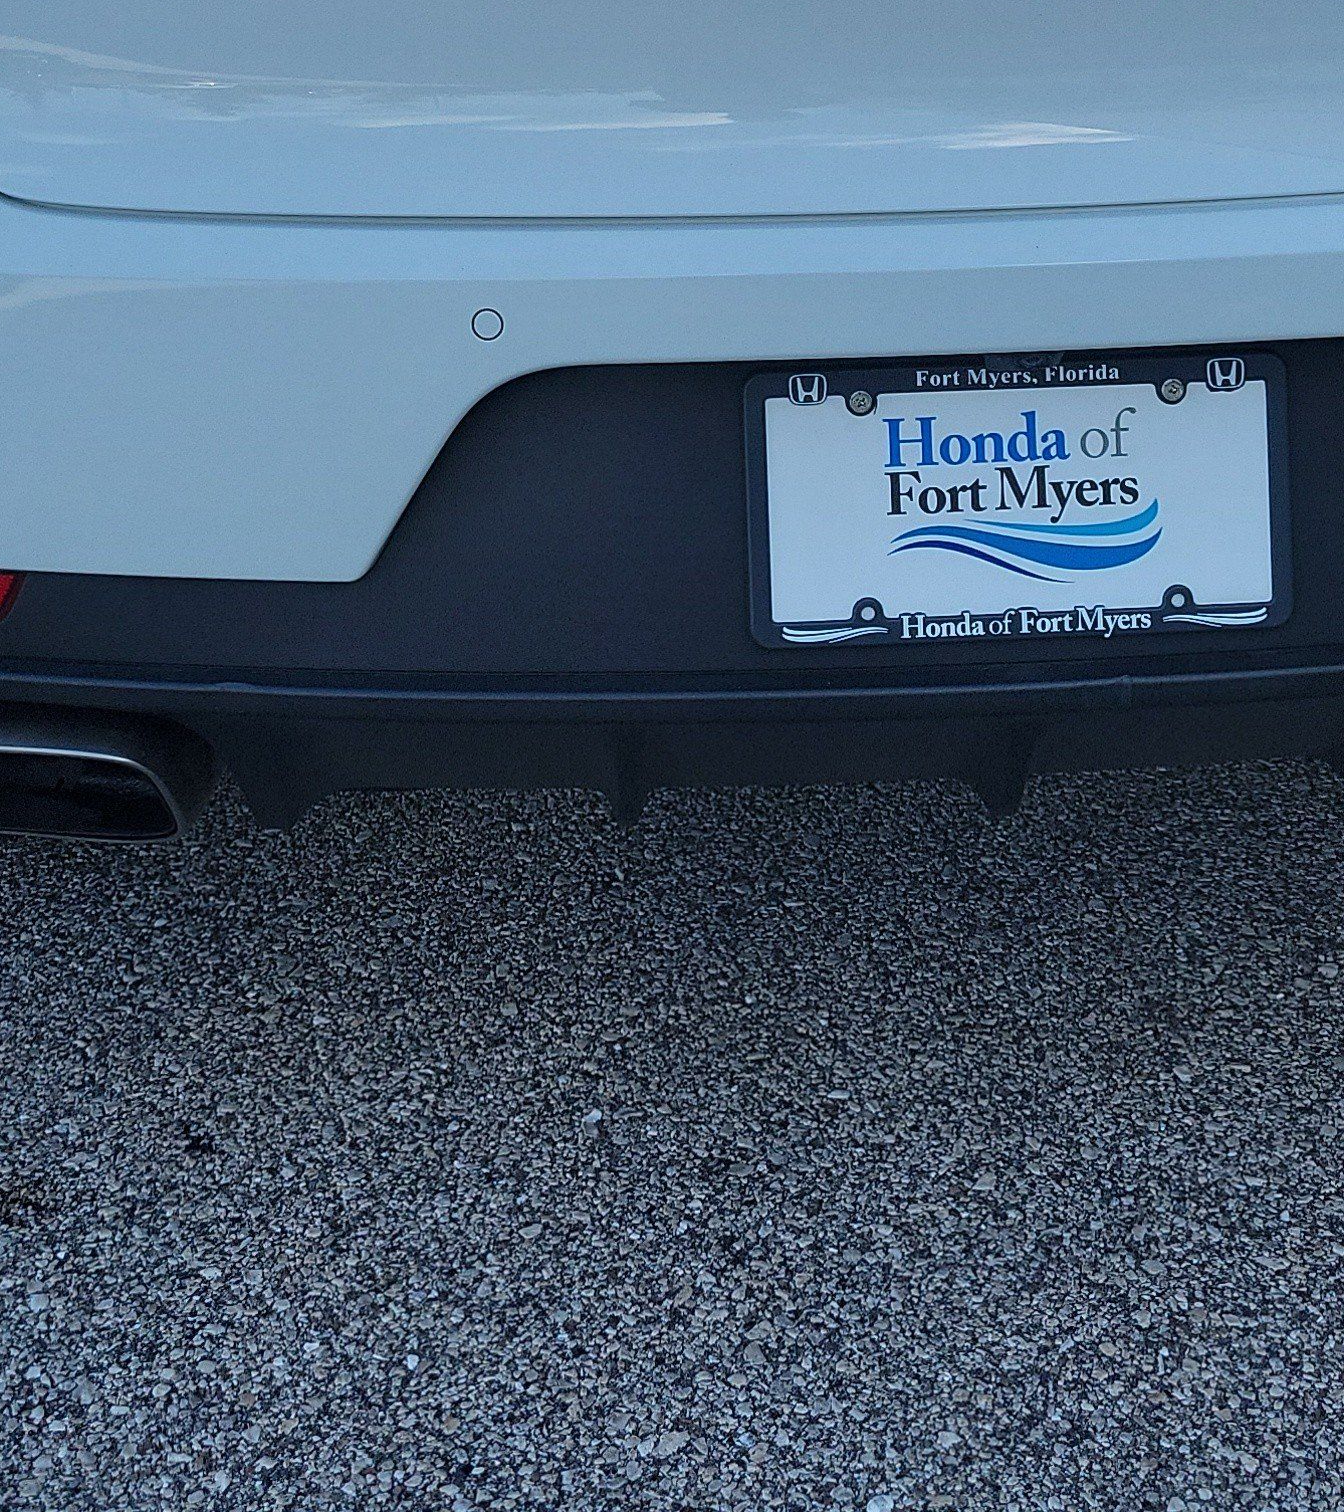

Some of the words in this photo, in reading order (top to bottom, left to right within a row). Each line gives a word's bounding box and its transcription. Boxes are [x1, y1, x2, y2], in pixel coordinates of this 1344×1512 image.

[915, 370, 960, 387] Fort
[967, 368, 1038, 388] Myers,
[1045, 364, 1120, 383] Florida
[882, 410, 1071, 468] Honda
[1080, 406, 1137, 459] of
[884, 470, 988, 516] Fort
[994, 464, 1139, 524] Myers
[900, 612, 985, 638] Honda
[989, 610, 1015, 635] of
[1019, 609, 1073, 634] Fort
[1075, 606, 1152, 638] Myers
